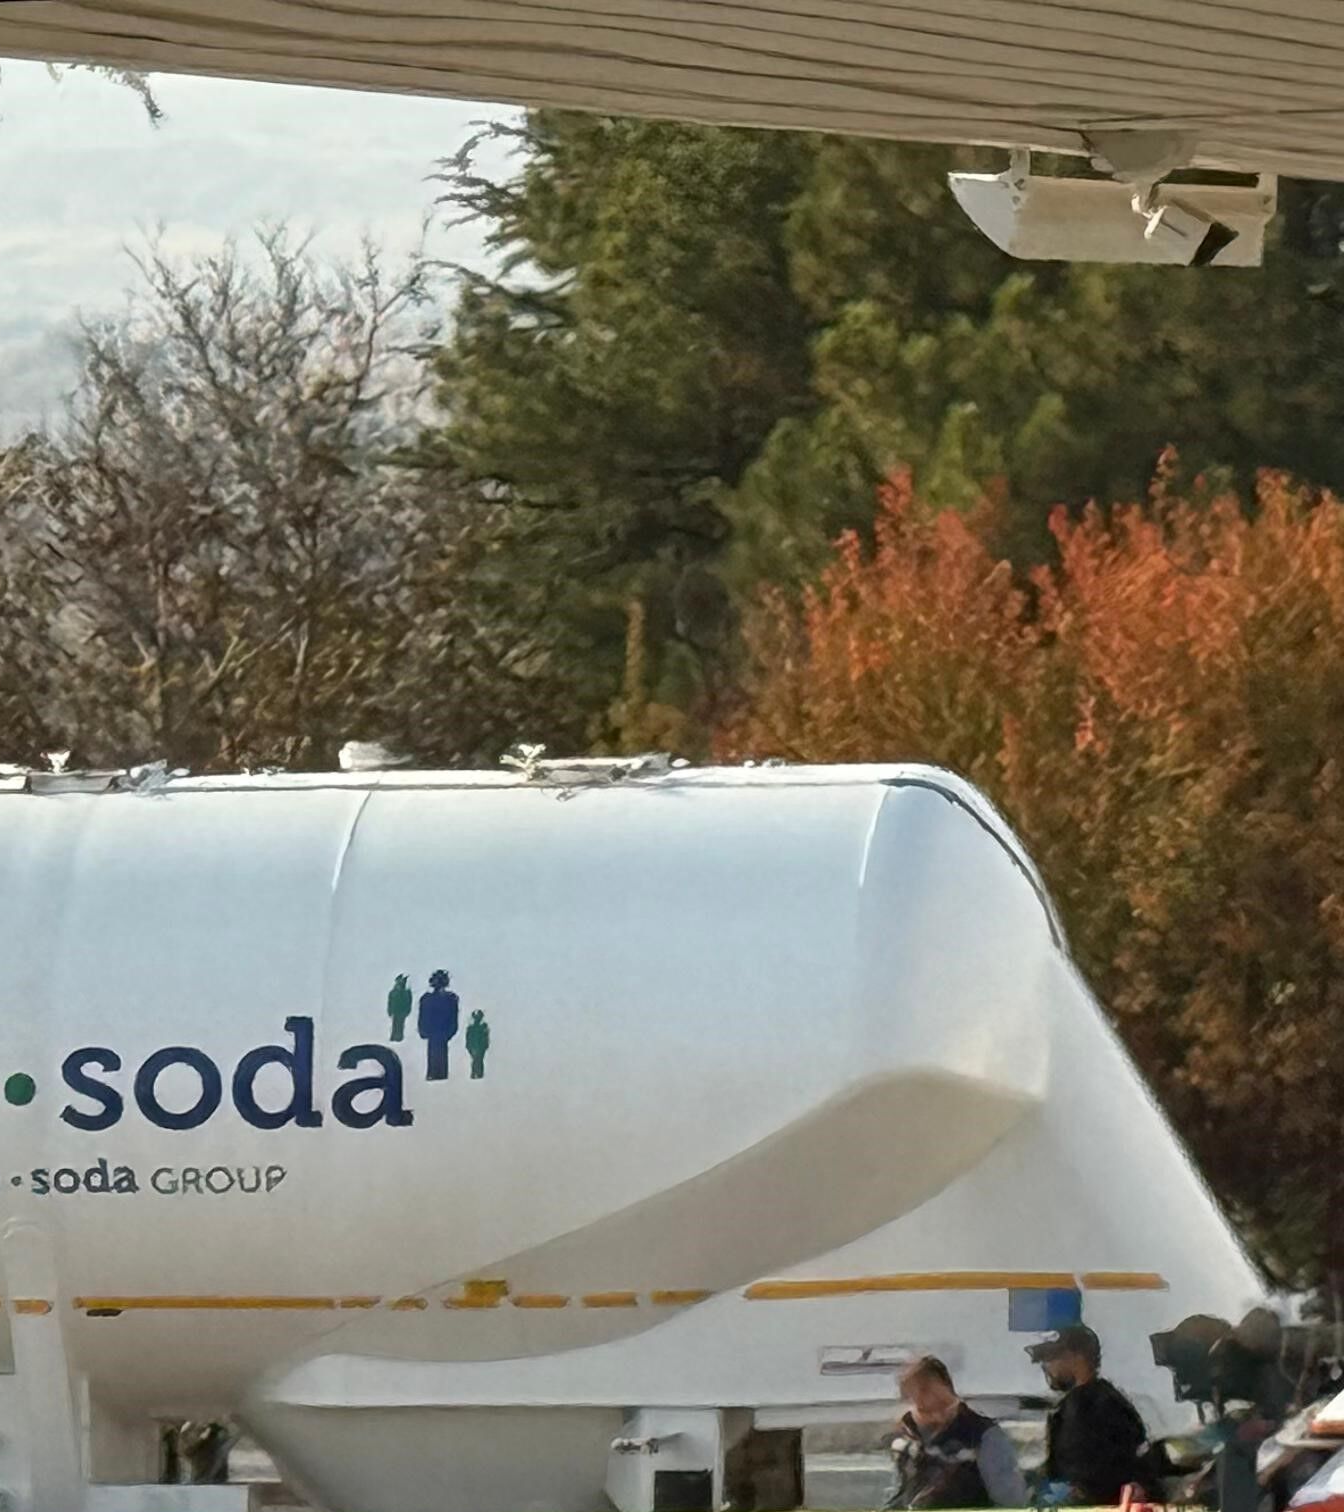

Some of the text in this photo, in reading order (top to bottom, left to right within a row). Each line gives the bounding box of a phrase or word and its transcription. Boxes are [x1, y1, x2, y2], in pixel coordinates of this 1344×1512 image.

[59, 1016, 414, 1131] soda
[31, 1157, 140, 1195] soda
[150, 1165, 287, 1195] GROUP
